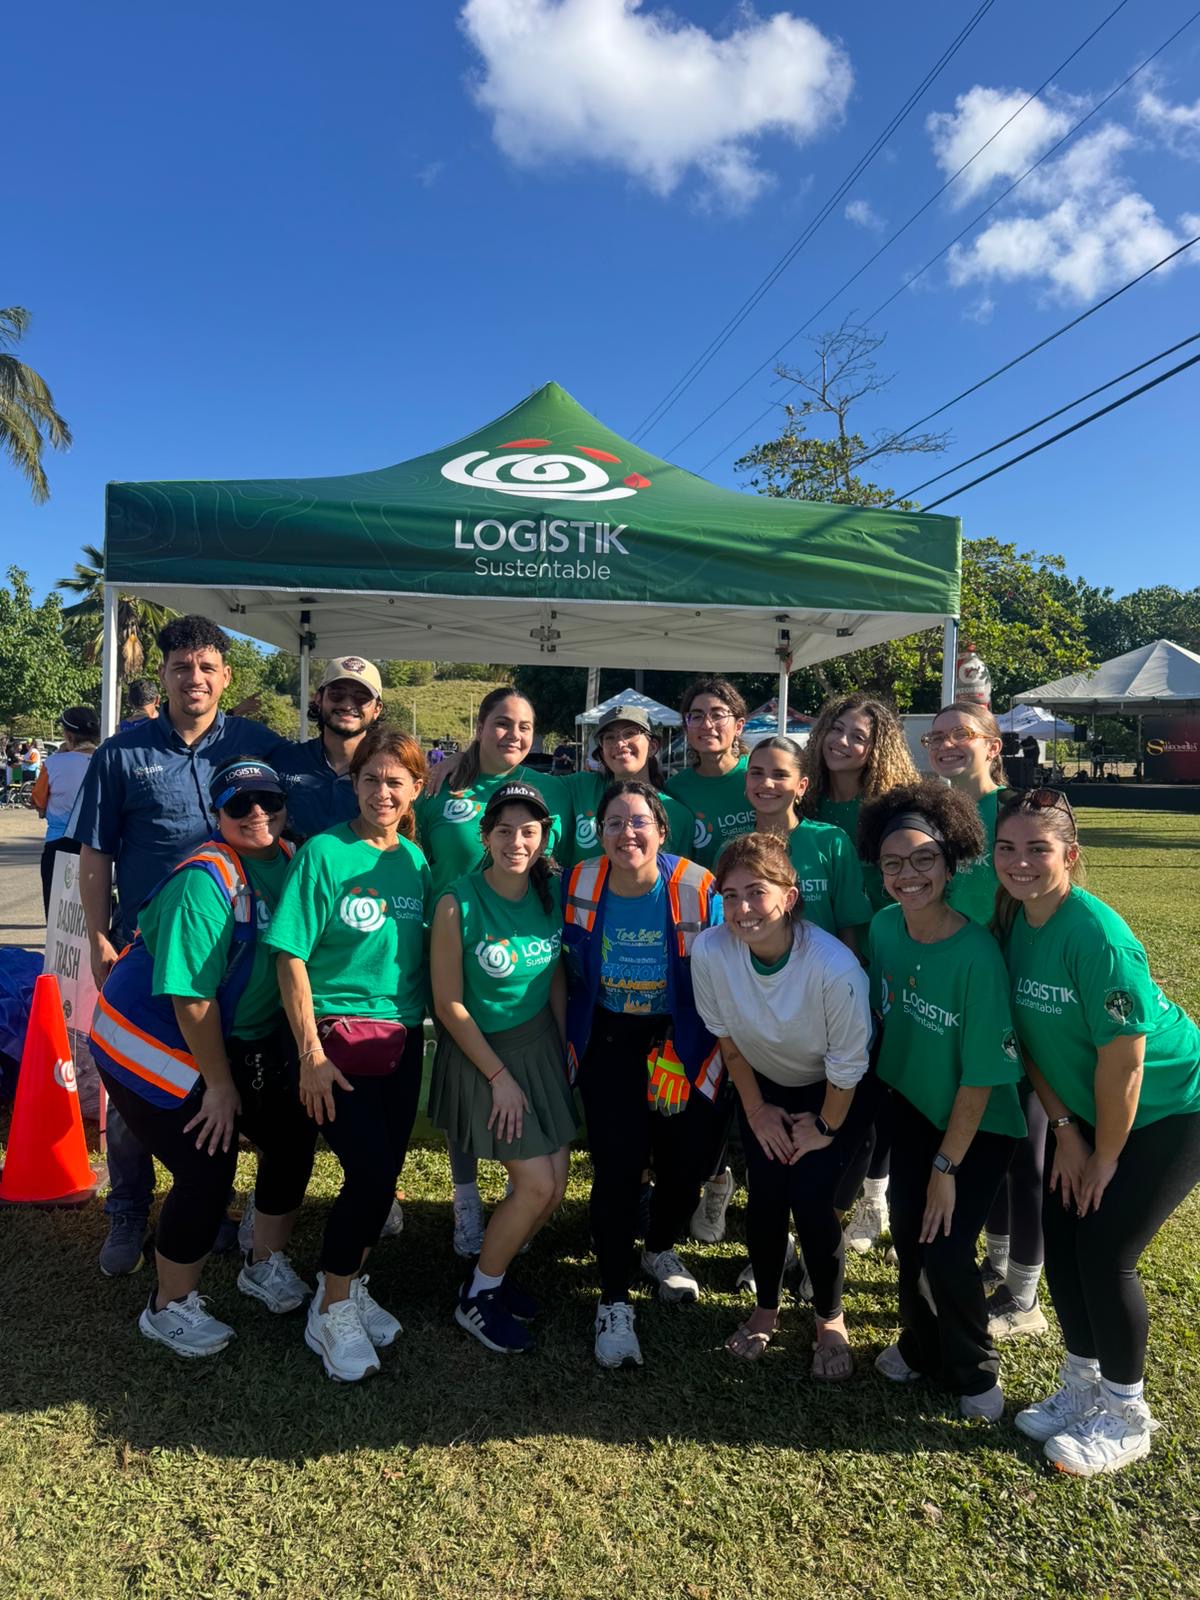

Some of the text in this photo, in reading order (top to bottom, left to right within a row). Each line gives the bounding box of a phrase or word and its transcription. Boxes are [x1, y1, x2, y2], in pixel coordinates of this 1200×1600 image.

[454, 519, 630, 555] LOGISTIK
[474, 556, 611, 581] Sustentable
[56, 899, 88, 939] BASURA
[54, 941, 81, 981] TRASH
[902, 988, 960, 1027] LOGISTIK
[1015, 994, 1062, 1015] Sustentable
[1017, 977, 1078, 1004] LOGISTIK
